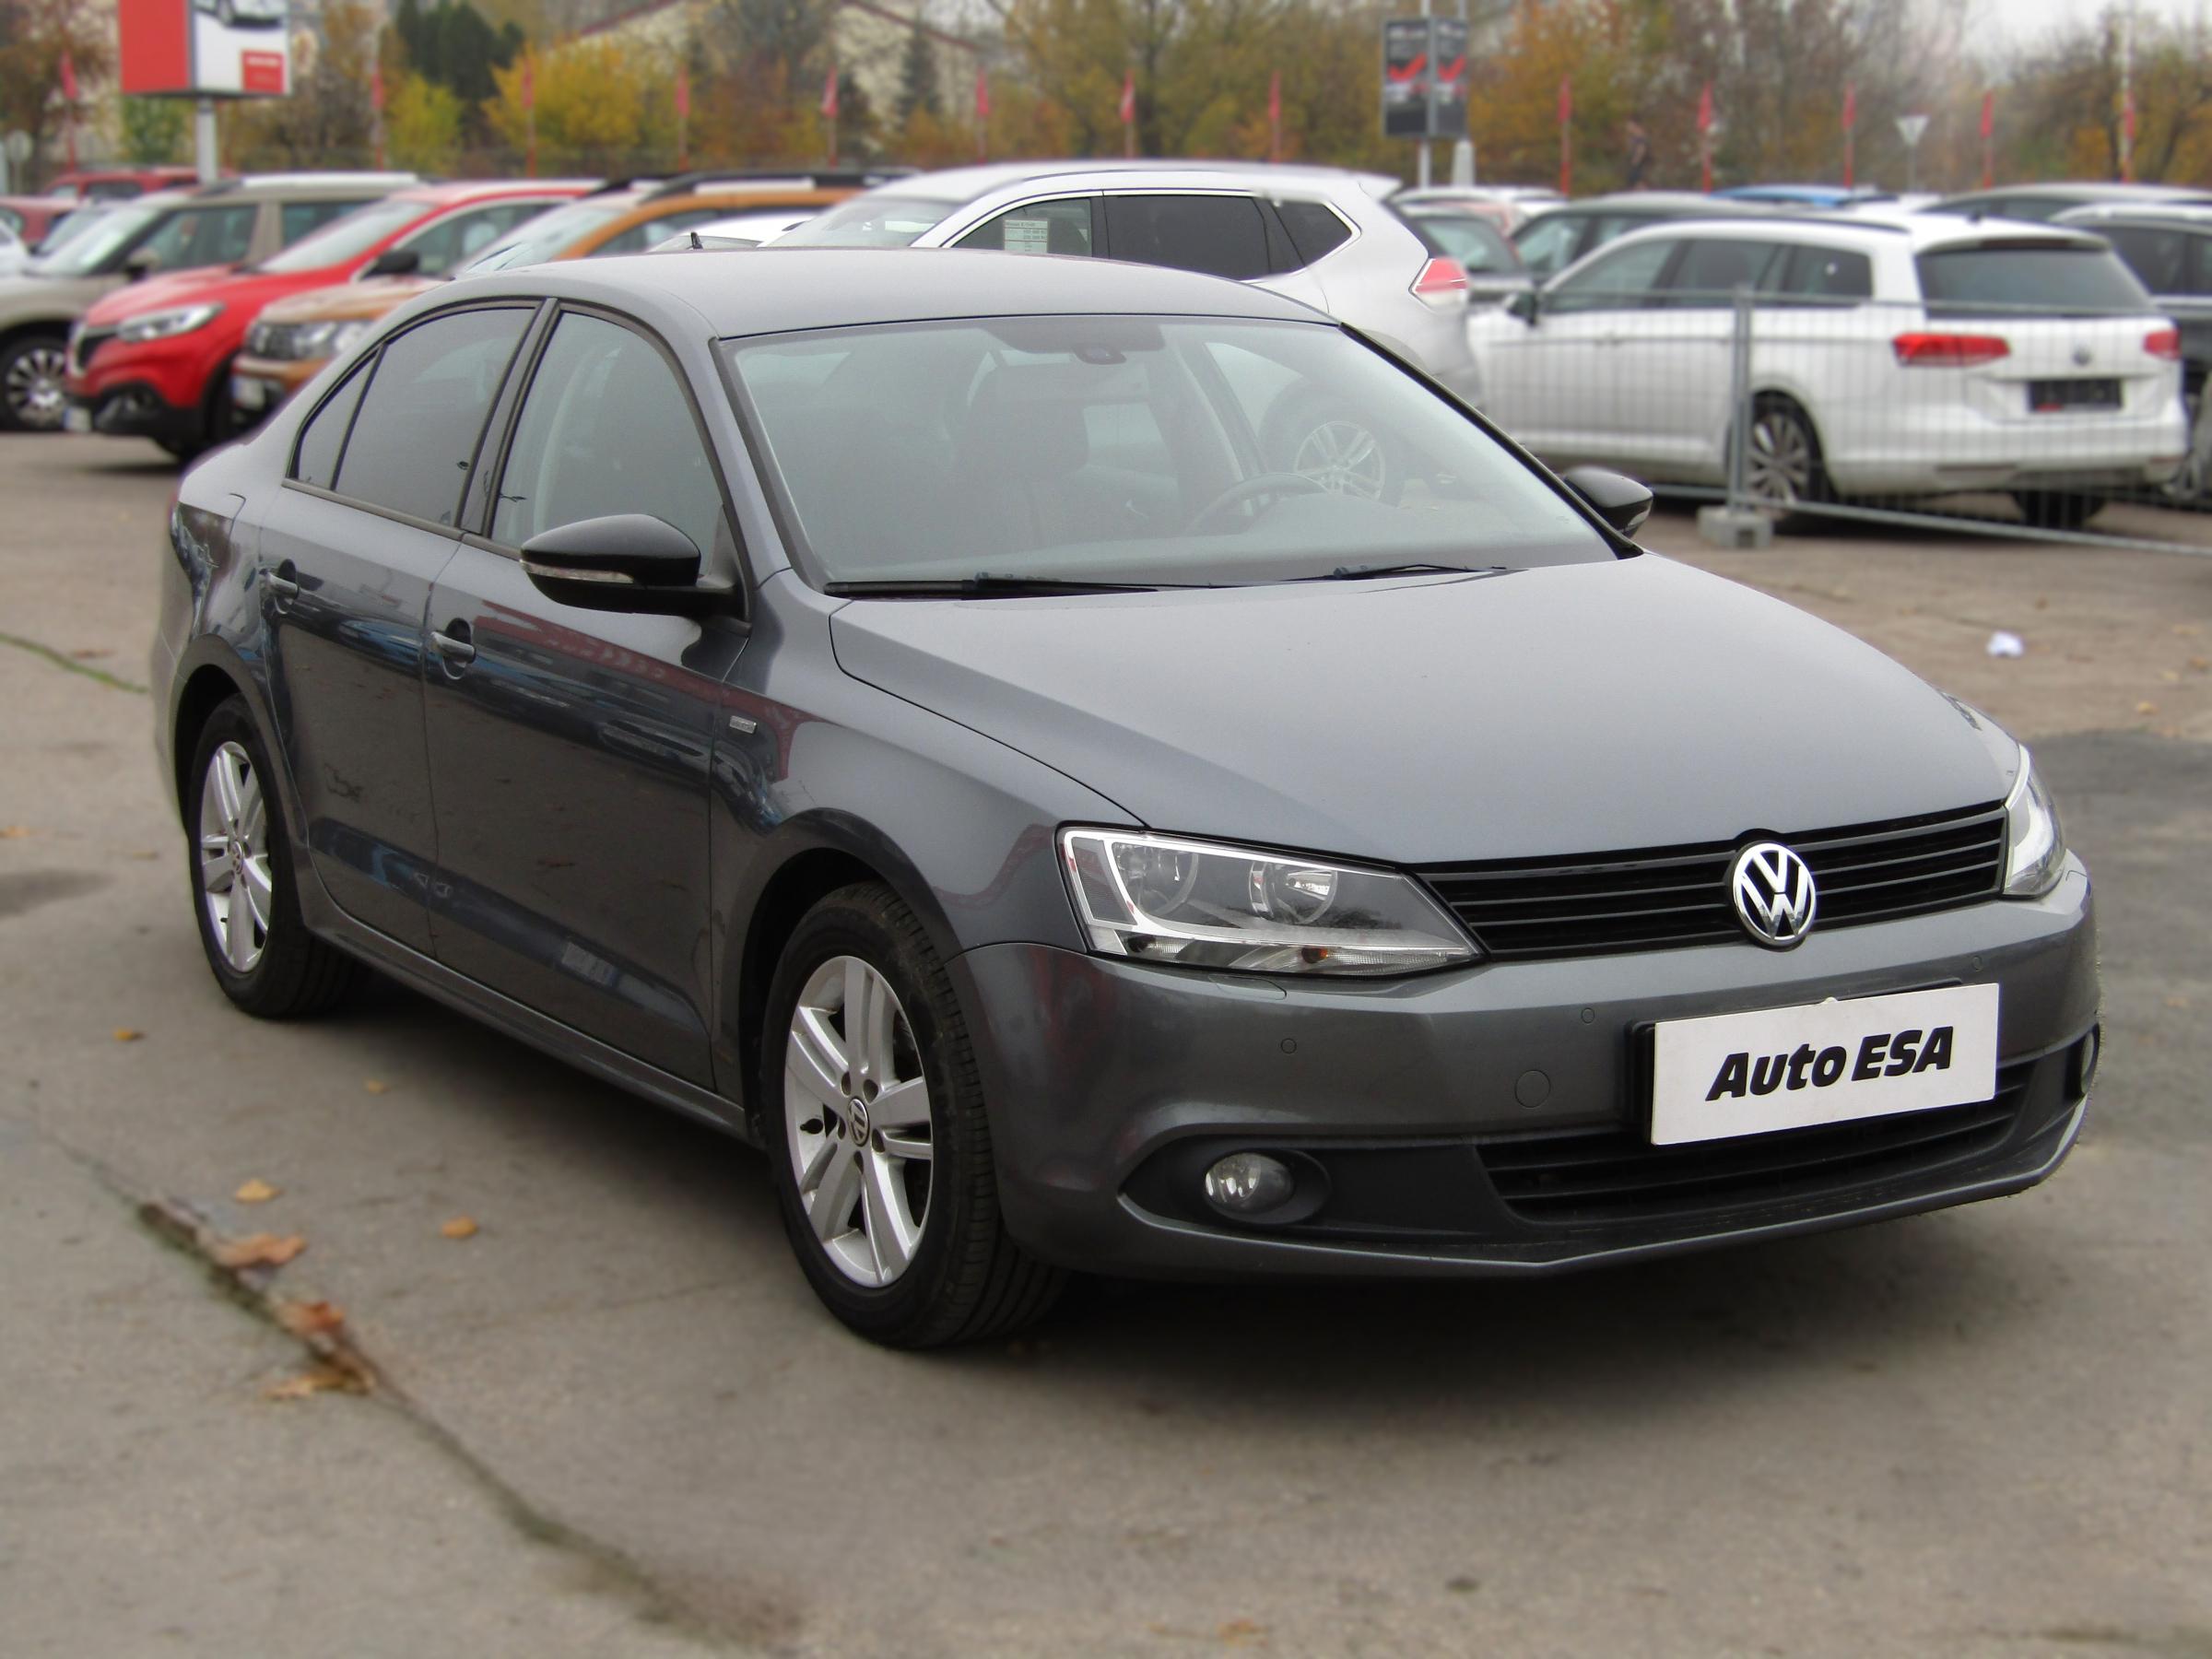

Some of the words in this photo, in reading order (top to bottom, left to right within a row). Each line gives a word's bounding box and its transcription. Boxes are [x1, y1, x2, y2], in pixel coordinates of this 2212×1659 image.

[1734, 843, 1816, 945] VW
[1705, 1043, 1846, 1100] Auto
[1851, 1026, 1953, 1081] ESA
